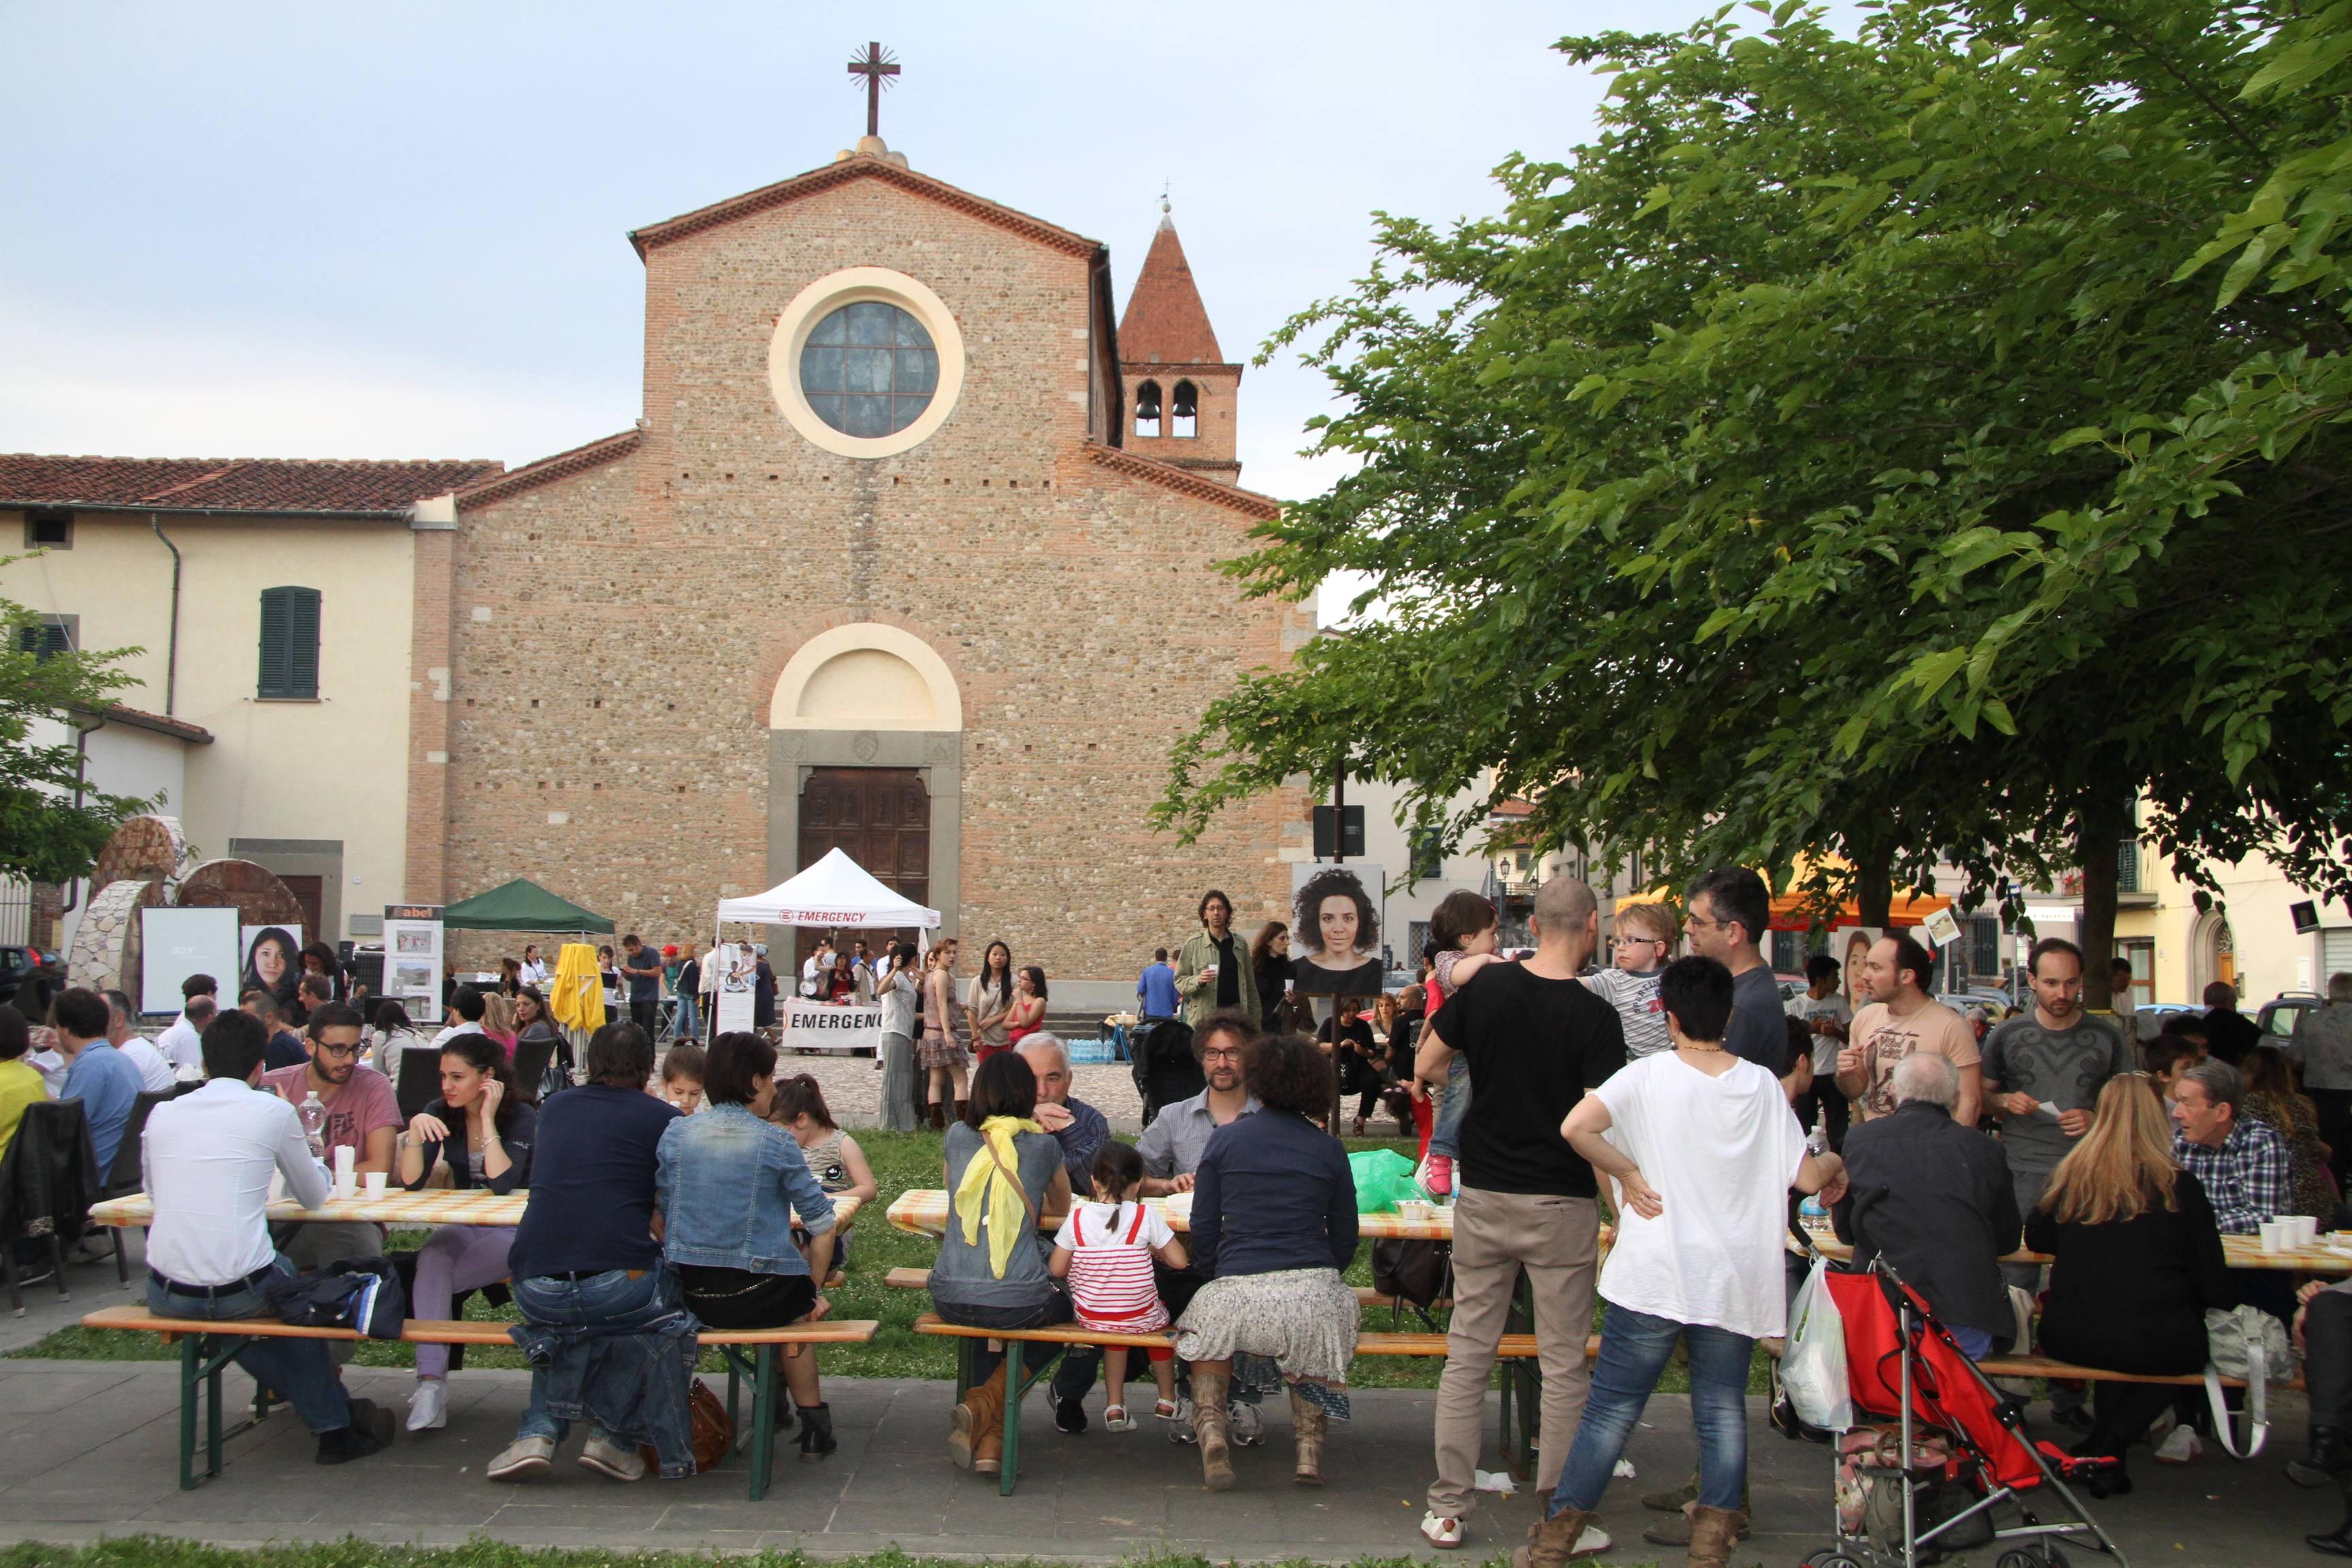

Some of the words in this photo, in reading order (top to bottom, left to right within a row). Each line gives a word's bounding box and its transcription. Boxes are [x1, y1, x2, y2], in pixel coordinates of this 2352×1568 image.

[798, 911, 866, 923] EMERGENCY
[1880, 1034, 1906, 1048] NEW
[1878, 1047, 1904, 1060] YORK
